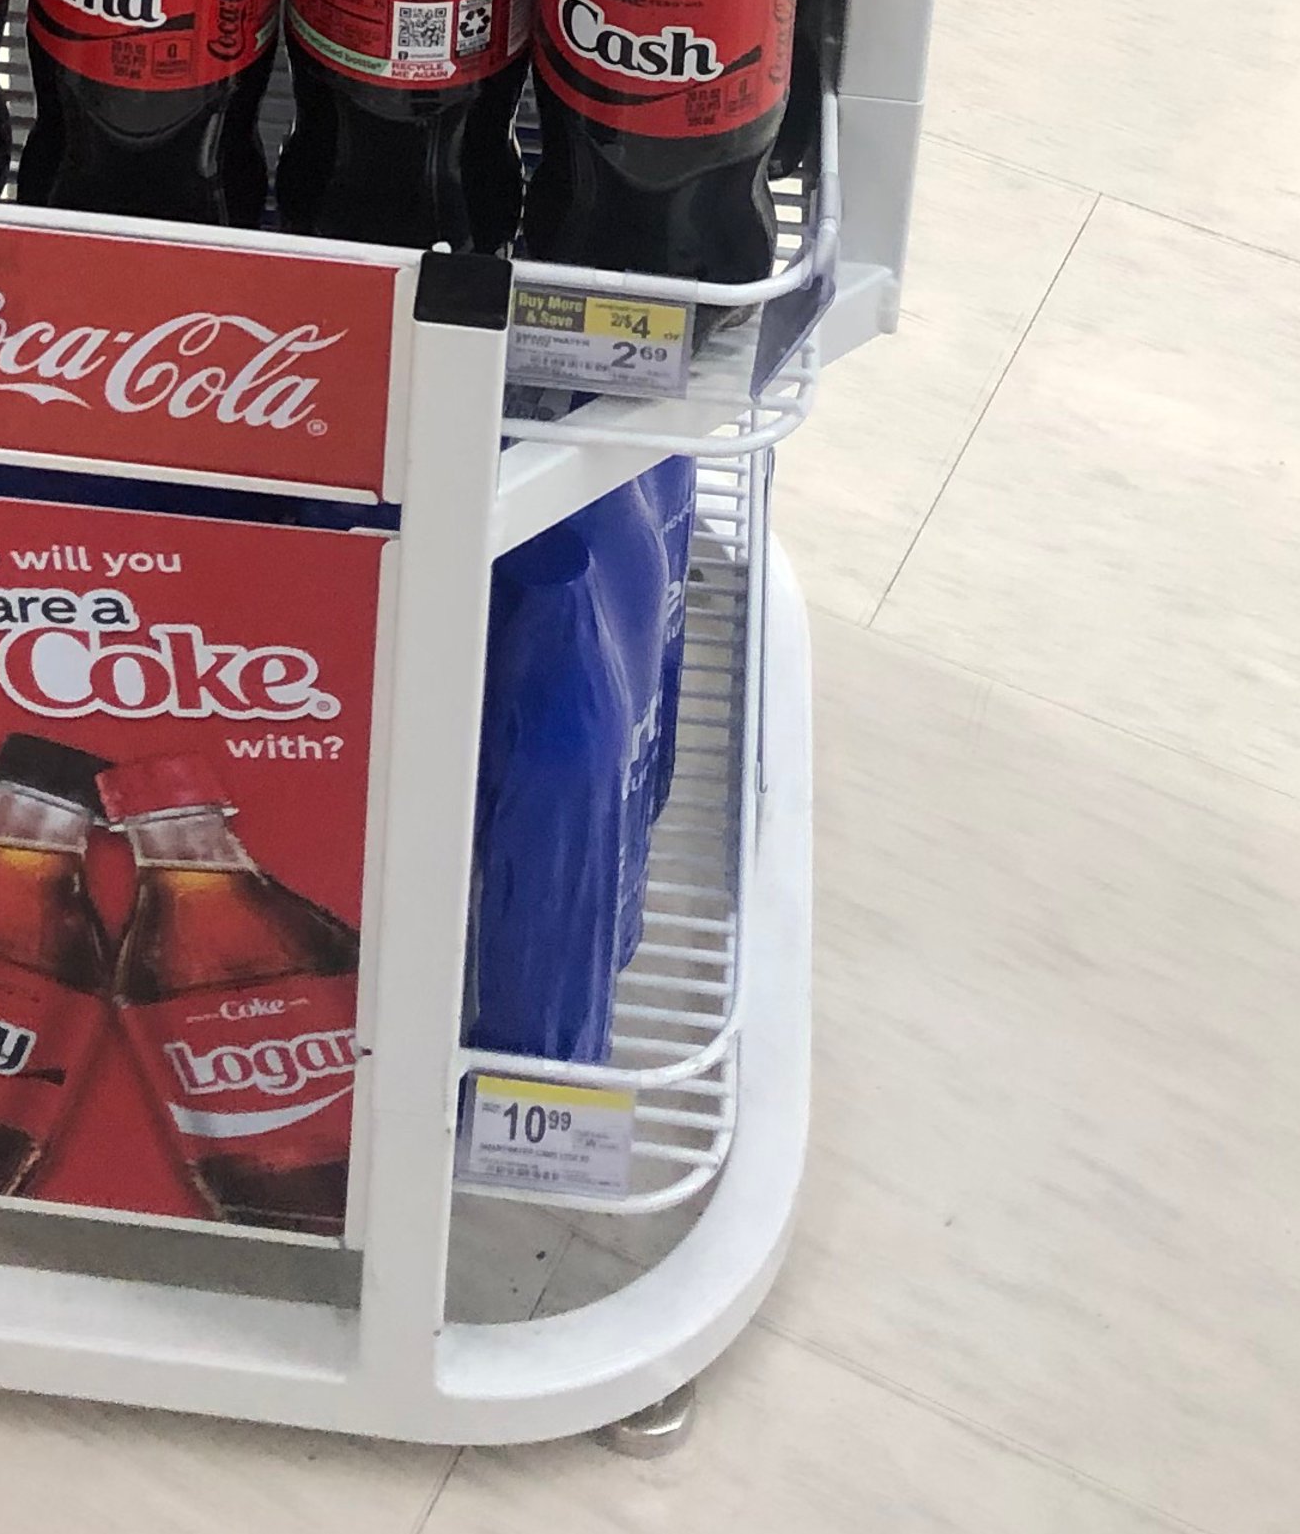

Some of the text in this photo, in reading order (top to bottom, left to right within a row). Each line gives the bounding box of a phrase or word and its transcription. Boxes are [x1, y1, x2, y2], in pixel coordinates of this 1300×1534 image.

[518, 293, 584, 312] Buy More
[540, 311, 574, 327] Save
[10, 544, 93, 573] will
[103, 549, 183, 578] you
[90, 593, 131, 626] a
[225, 734, 345, 762] with?
[219, 996, 287, 1022] Coke
